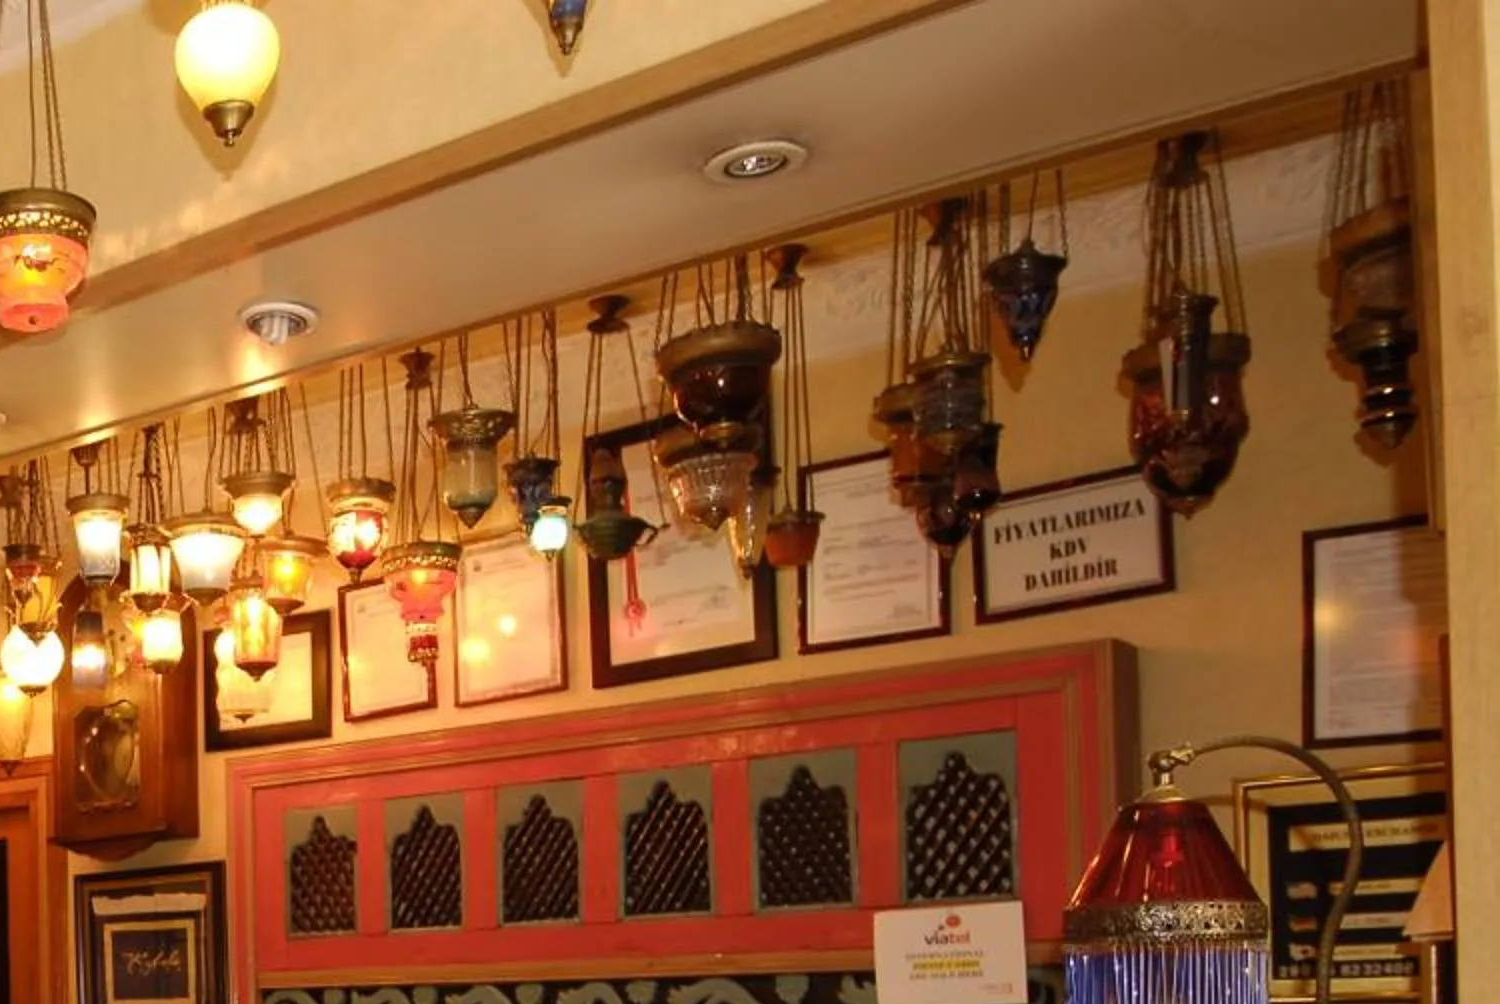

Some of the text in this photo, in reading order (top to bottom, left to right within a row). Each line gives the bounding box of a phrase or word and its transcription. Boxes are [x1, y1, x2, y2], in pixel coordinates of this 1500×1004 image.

[994, 498, 1146, 545] FİYATLARIMIZA
[1049, 535, 1090, 561] KDV
[1024, 556, 1118, 591] DAHİLDİR
